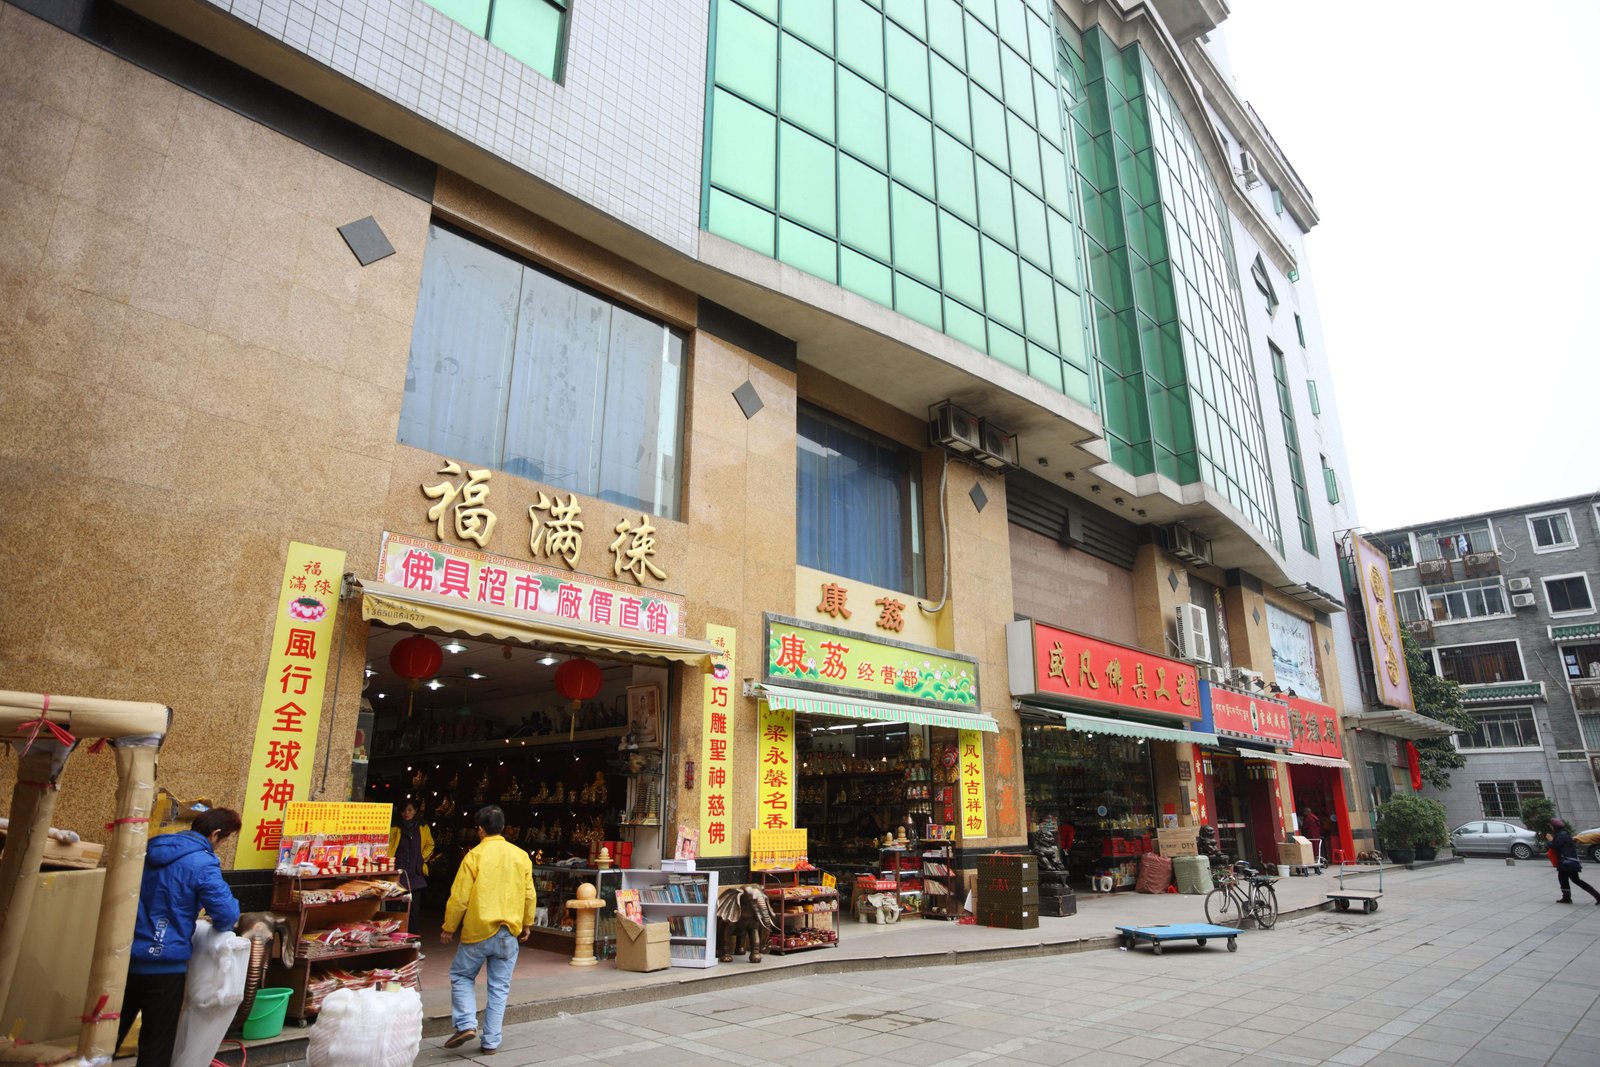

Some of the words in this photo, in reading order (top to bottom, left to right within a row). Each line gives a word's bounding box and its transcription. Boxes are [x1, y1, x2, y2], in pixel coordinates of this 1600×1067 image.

[817, 582, 906, 632] 康荔
[776, 633, 850, 680] 康荔
[857, 661, 919, 689] 经营部
[707, 686, 728, 845] 巧雕聖神慈佛
[963, 744, 983, 831] 风水吉祥物
